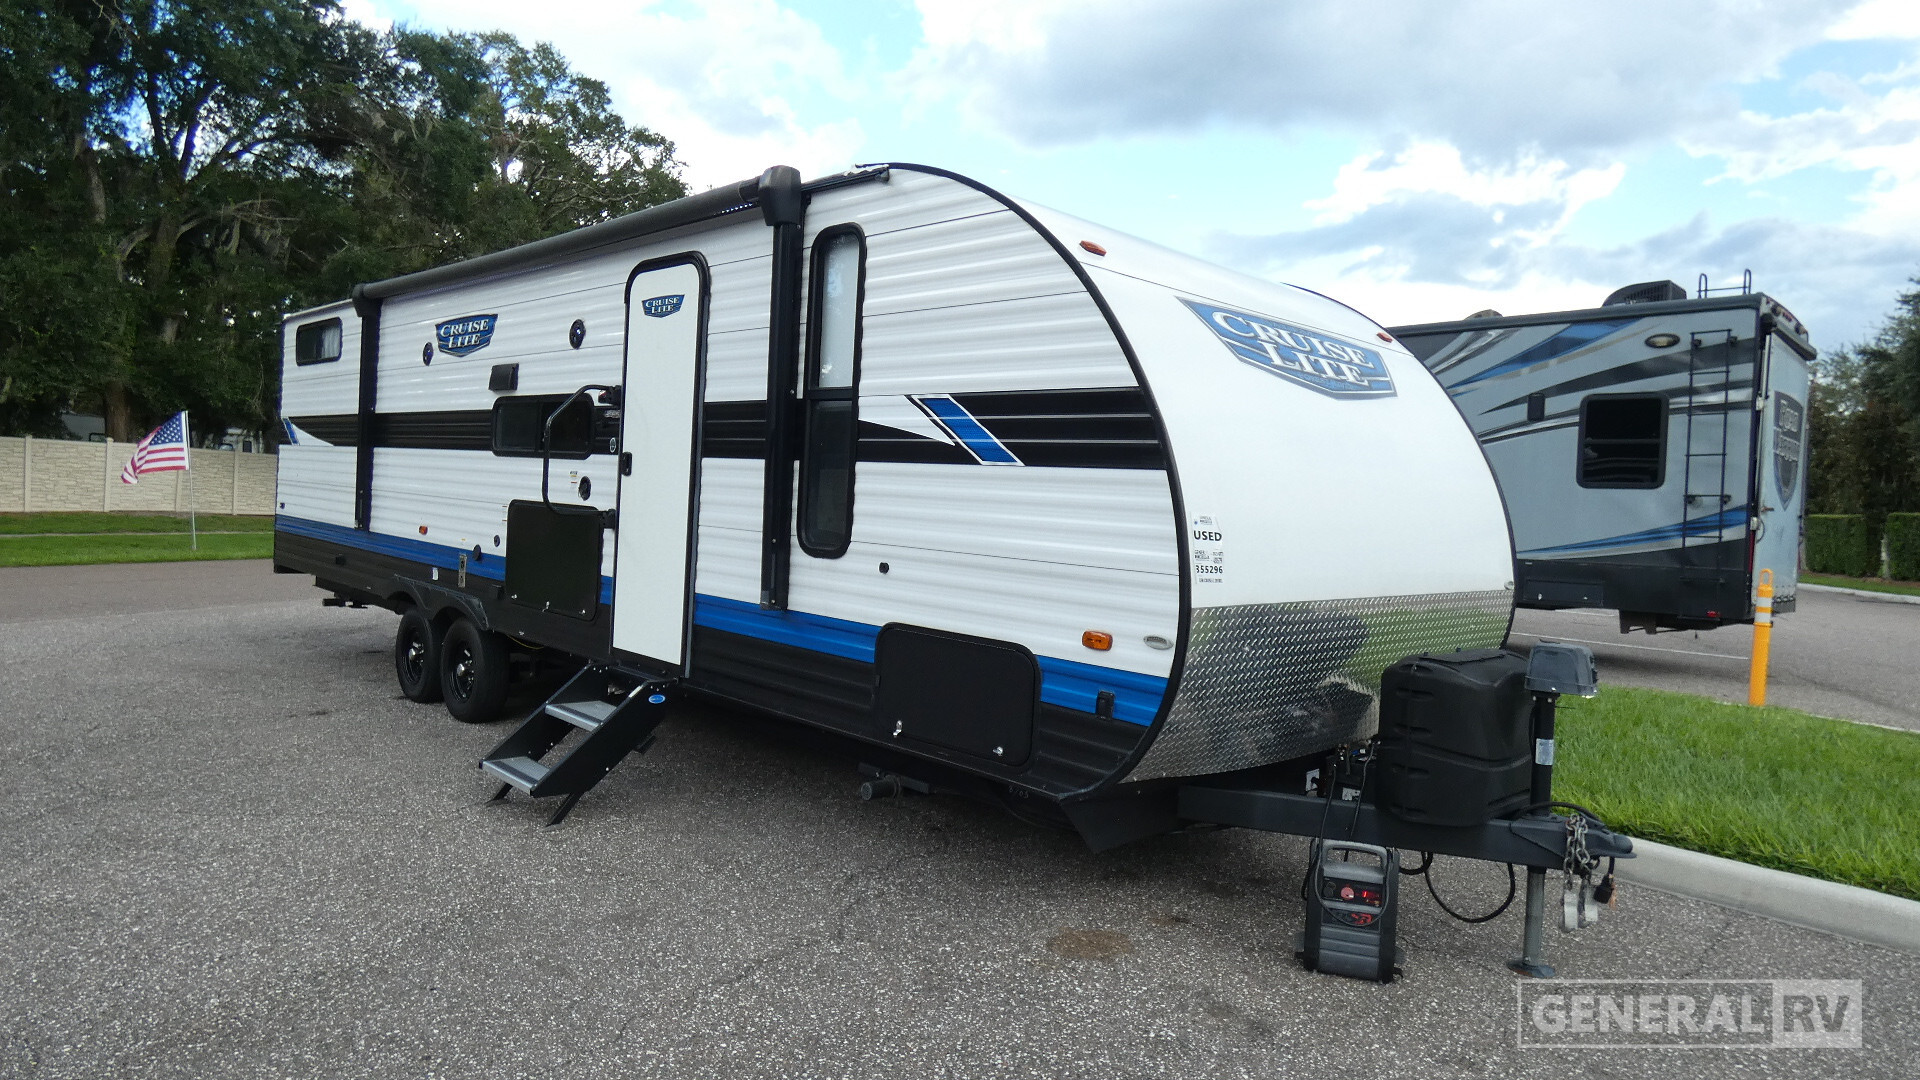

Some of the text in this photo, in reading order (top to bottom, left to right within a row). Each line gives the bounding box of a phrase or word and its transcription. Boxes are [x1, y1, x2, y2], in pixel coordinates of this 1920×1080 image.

[645, 296, 680, 307] CRUISE
[651, 304, 674, 314] LITE
[440, 318, 489, 338] CRUISE
[448, 333, 481, 349] LITE
[1212, 310, 1374, 369] CRUISE
[1257, 339, 1370, 387] LITE
[1193, 530, 1222, 541] USED
